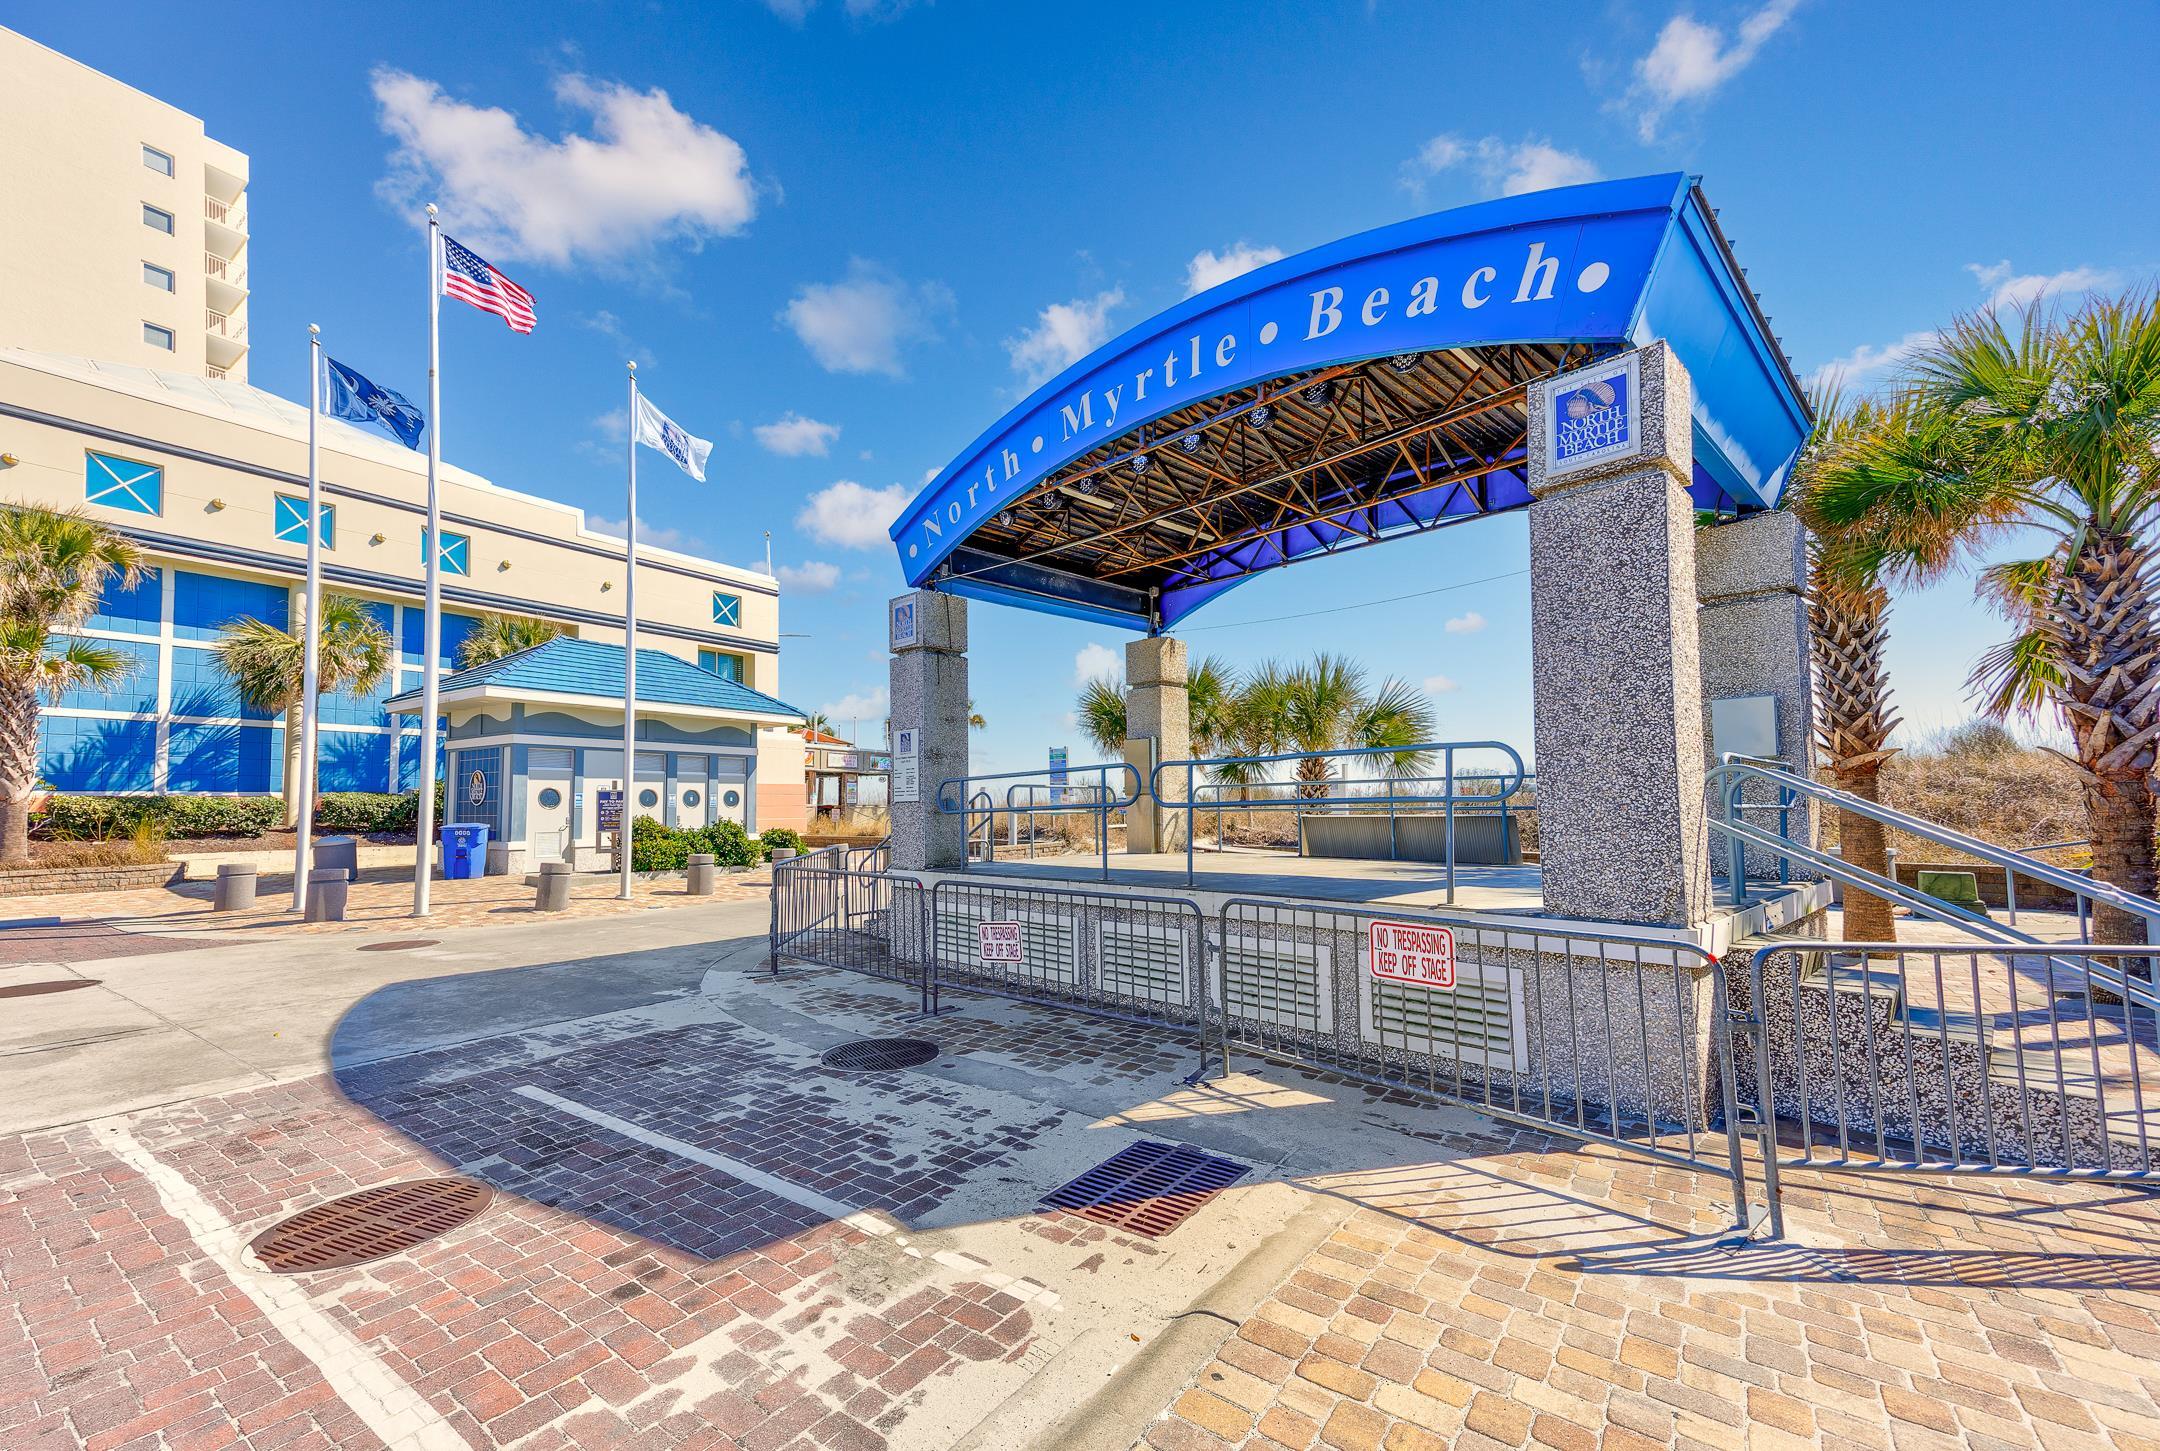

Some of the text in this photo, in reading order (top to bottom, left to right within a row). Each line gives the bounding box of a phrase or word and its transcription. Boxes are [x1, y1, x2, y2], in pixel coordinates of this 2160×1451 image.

[922, 242, 1559, 549] North Myrtle Beach
[1559, 417, 1626, 447] MYRTLE
[1561, 405, 1623, 433] NORTH
[1563, 431, 1622, 458] BEACH
[981, 927, 1018, 941] NO TRESPASSING
[1376, 927, 1446, 956] NO TRESPASSING
[983, 943, 1019, 958] KEEP OFF STAGE
[1378, 951, 1447, 982] KEEP OFF STAGE
